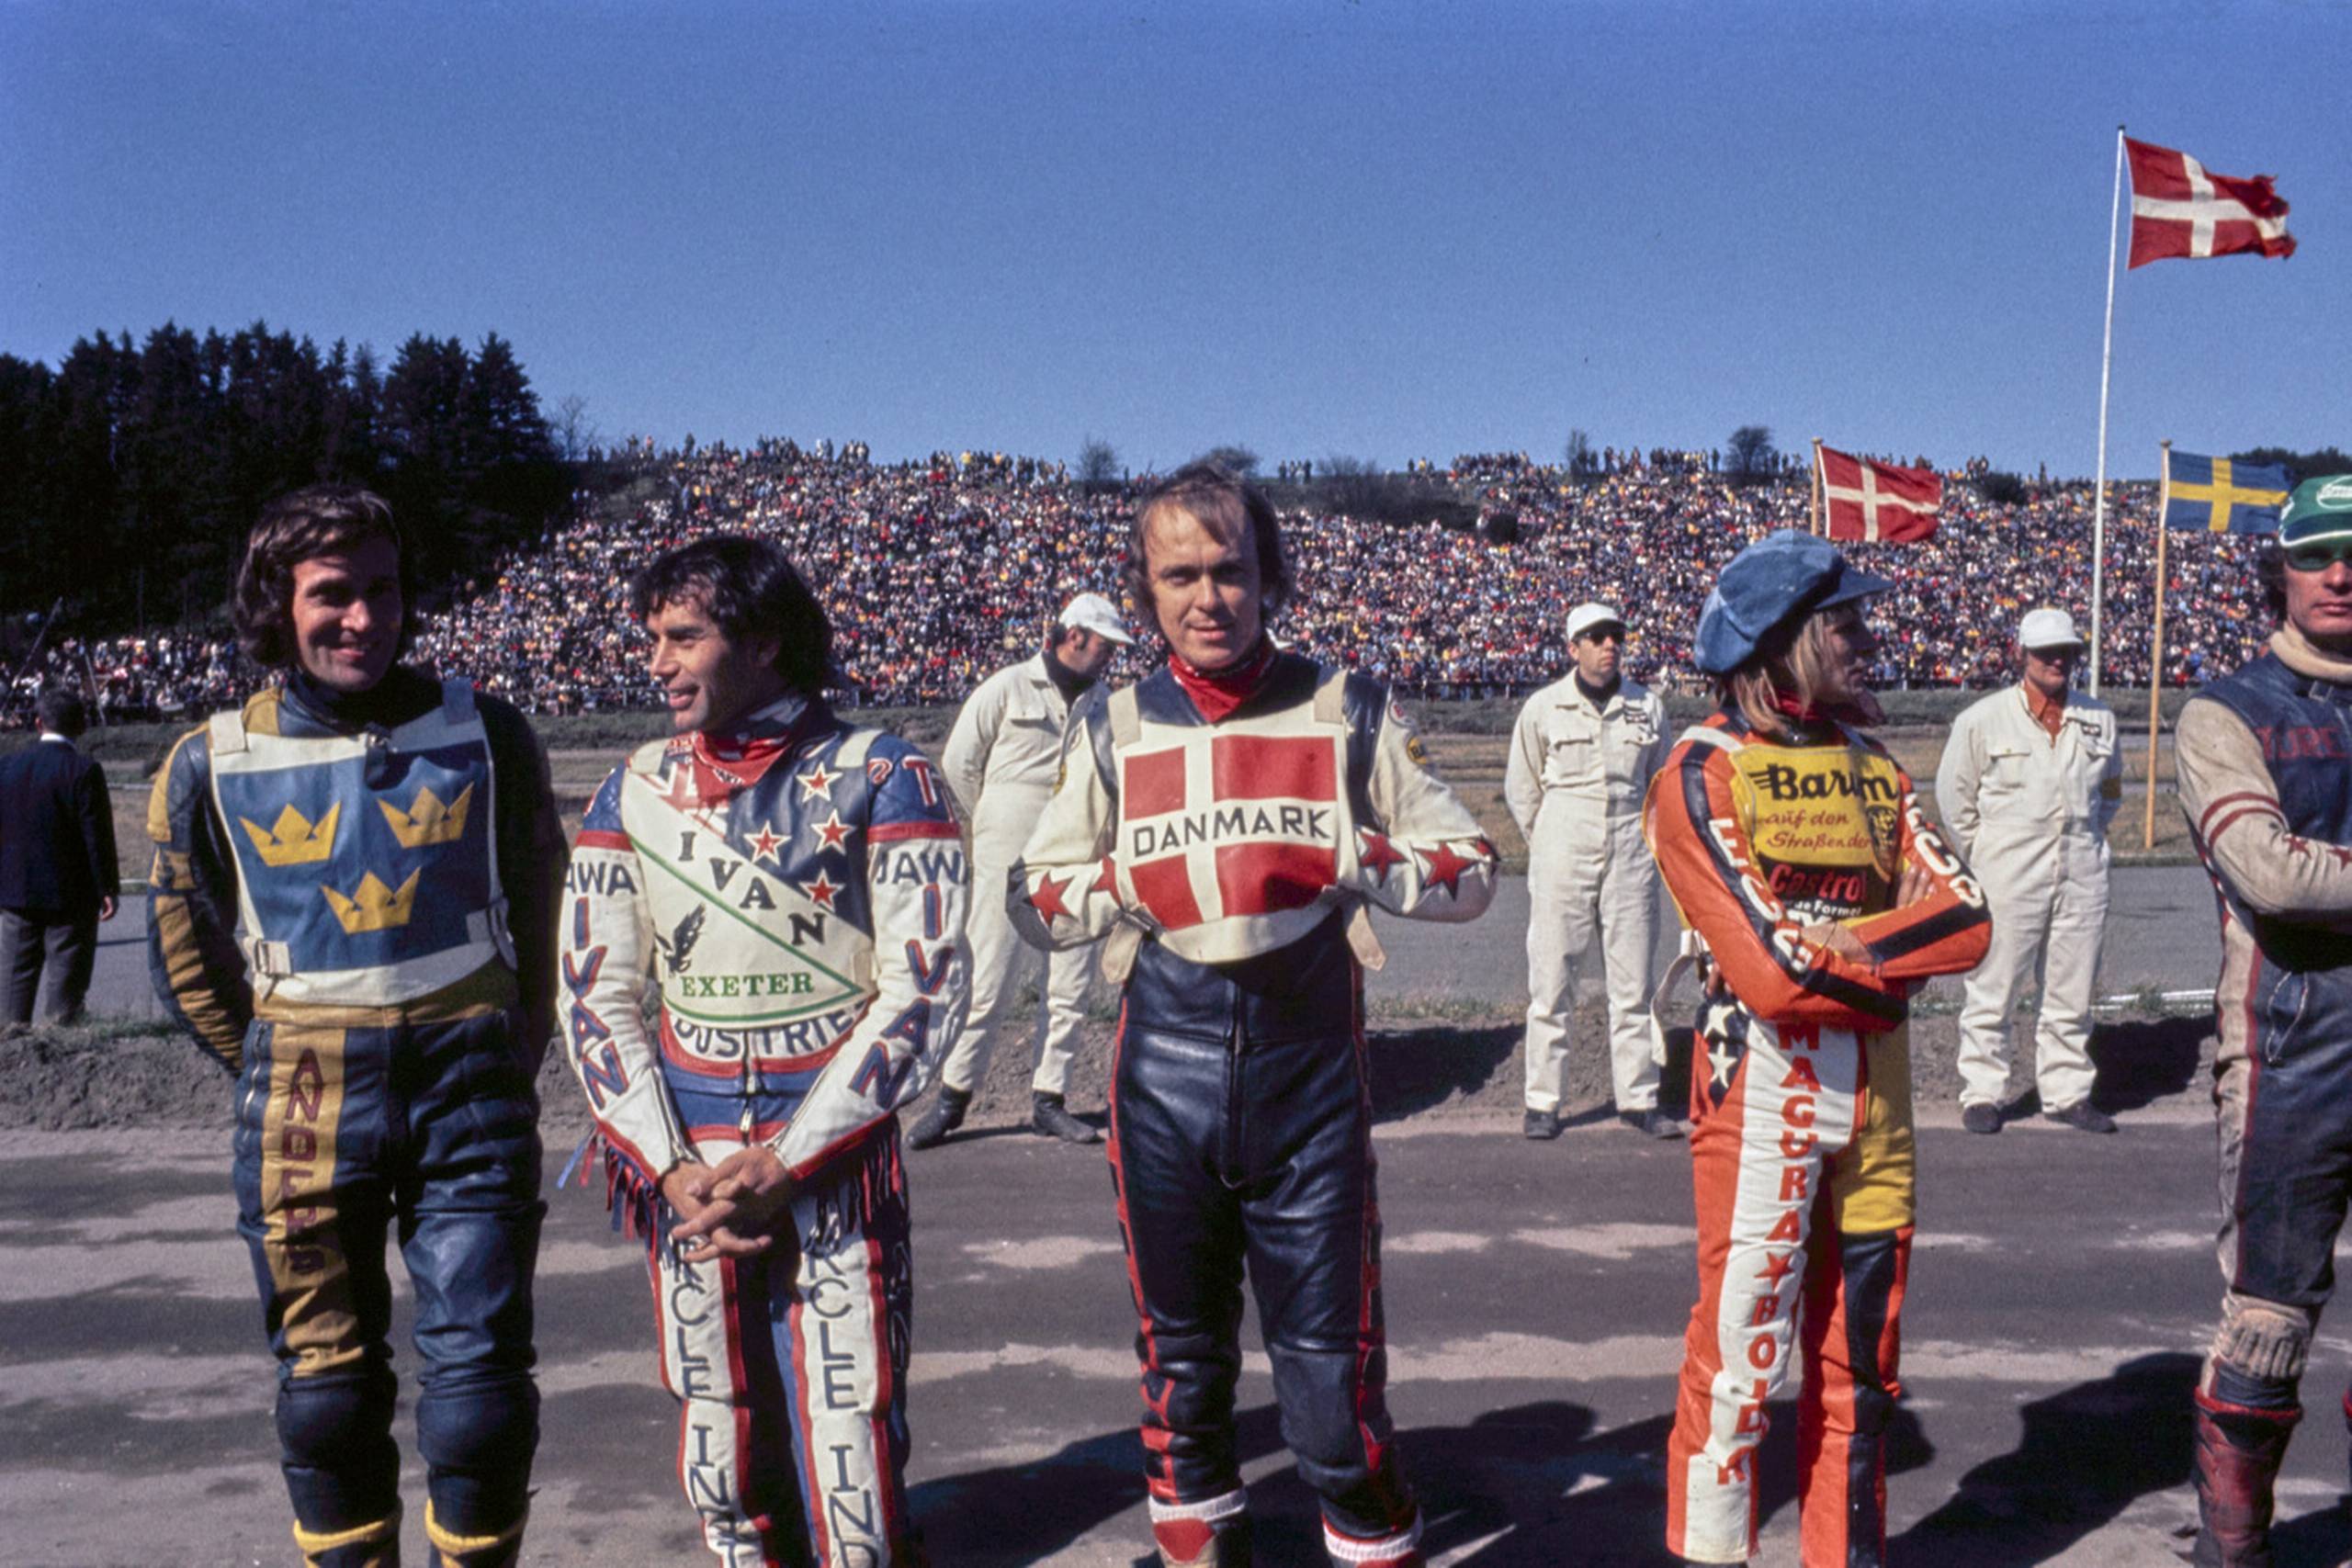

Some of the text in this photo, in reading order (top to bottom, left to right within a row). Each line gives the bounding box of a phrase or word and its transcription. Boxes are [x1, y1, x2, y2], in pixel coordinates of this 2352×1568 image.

[1747, 762, 1899, 801] Barum
[1133, 805, 1331, 857] DANMARK
[564, 861, 639, 897] AWA
[679, 830, 826, 947] IVAN
[876, 850, 971, 886] JAW
[562, 897, 630, 1110] IVAN
[681, 972, 815, 998] EXETER
[849, 883, 954, 1109] IVAN
[674, 1000, 866, 1057] DUSTRIE
[1765, 1020, 1823, 1244] MAGURA
